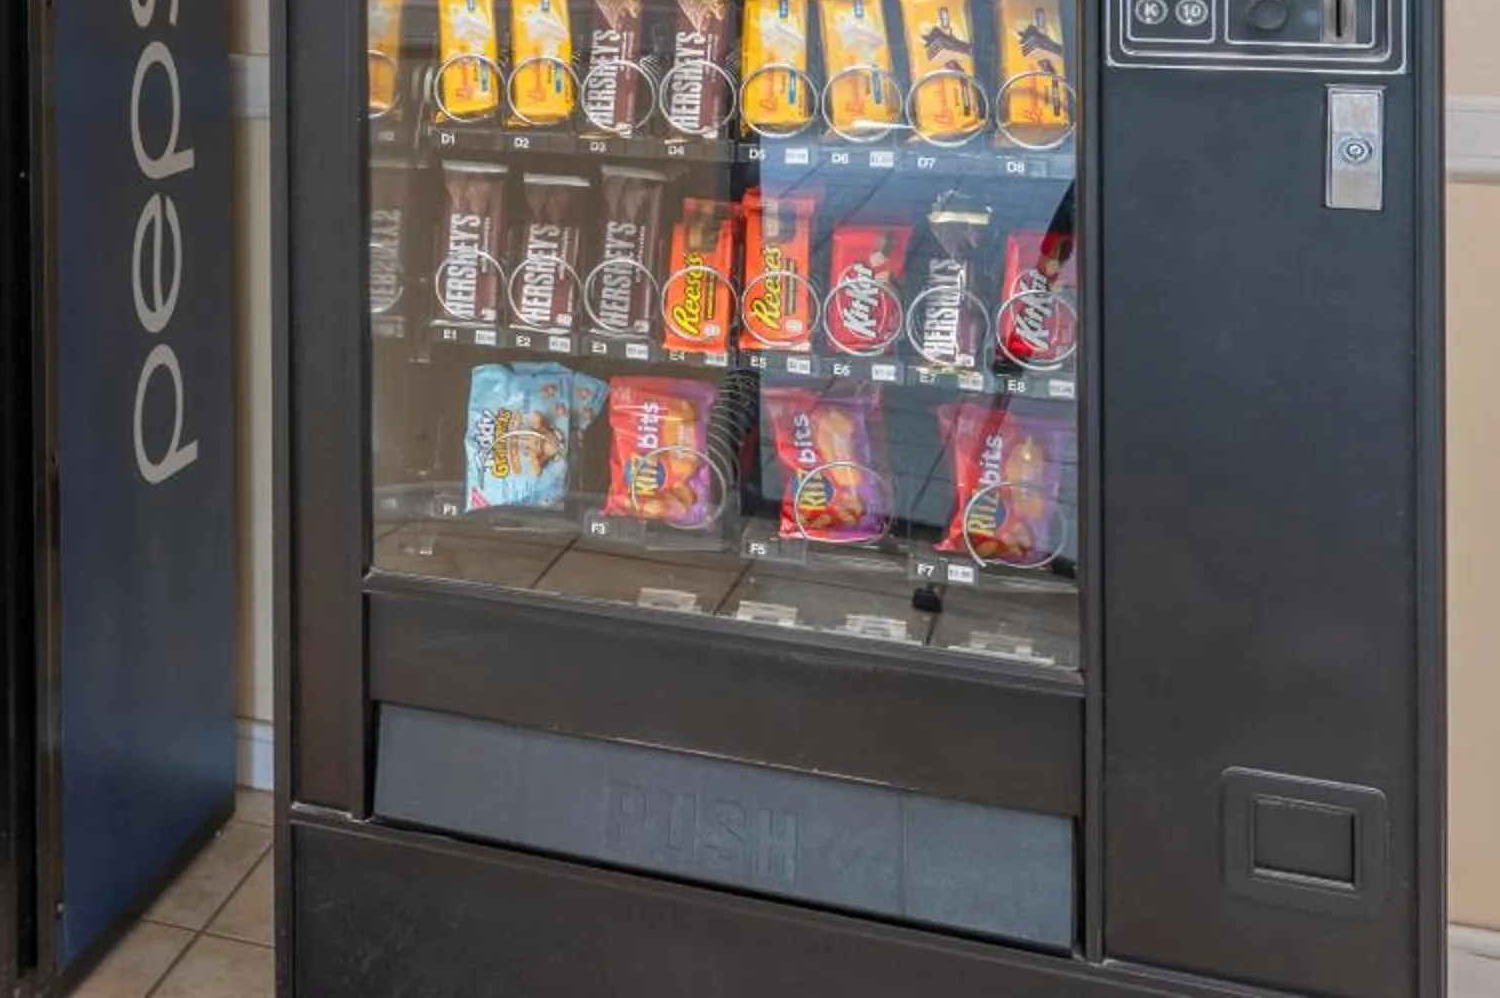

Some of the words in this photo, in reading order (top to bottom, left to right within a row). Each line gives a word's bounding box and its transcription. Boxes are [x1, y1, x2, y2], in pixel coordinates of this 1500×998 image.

[1144, 2, 1158, 17] K
[1181, 4, 1202, 17] 10
[588, 28, 621, 128] HERSHEY'S
[671, 30, 707, 129] HERSHEY'S
[442, 133, 456, 145] D1
[514, 137, 529, 148] D2
[832, 153, 848, 164] D6
[917, 157, 936, 169] D7
[1007, 161, 1025, 173] D8
[446, 212, 481, 320] HERSHEY'S
[521, 223, 560, 327] HERSHEY'S
[600, 220, 637, 331] HERSHEY'S
[516, 335, 531, 347] E2
[834, 363, 850, 376] E6
[1008, 379, 1026, 392] E8
[637, 402, 660, 449] bits
[793, 413, 817, 464] bits
[979, 434, 1002, 485] bits
[917, 564, 934, 576] F7
[607, 780, 799, 888] PUSH
